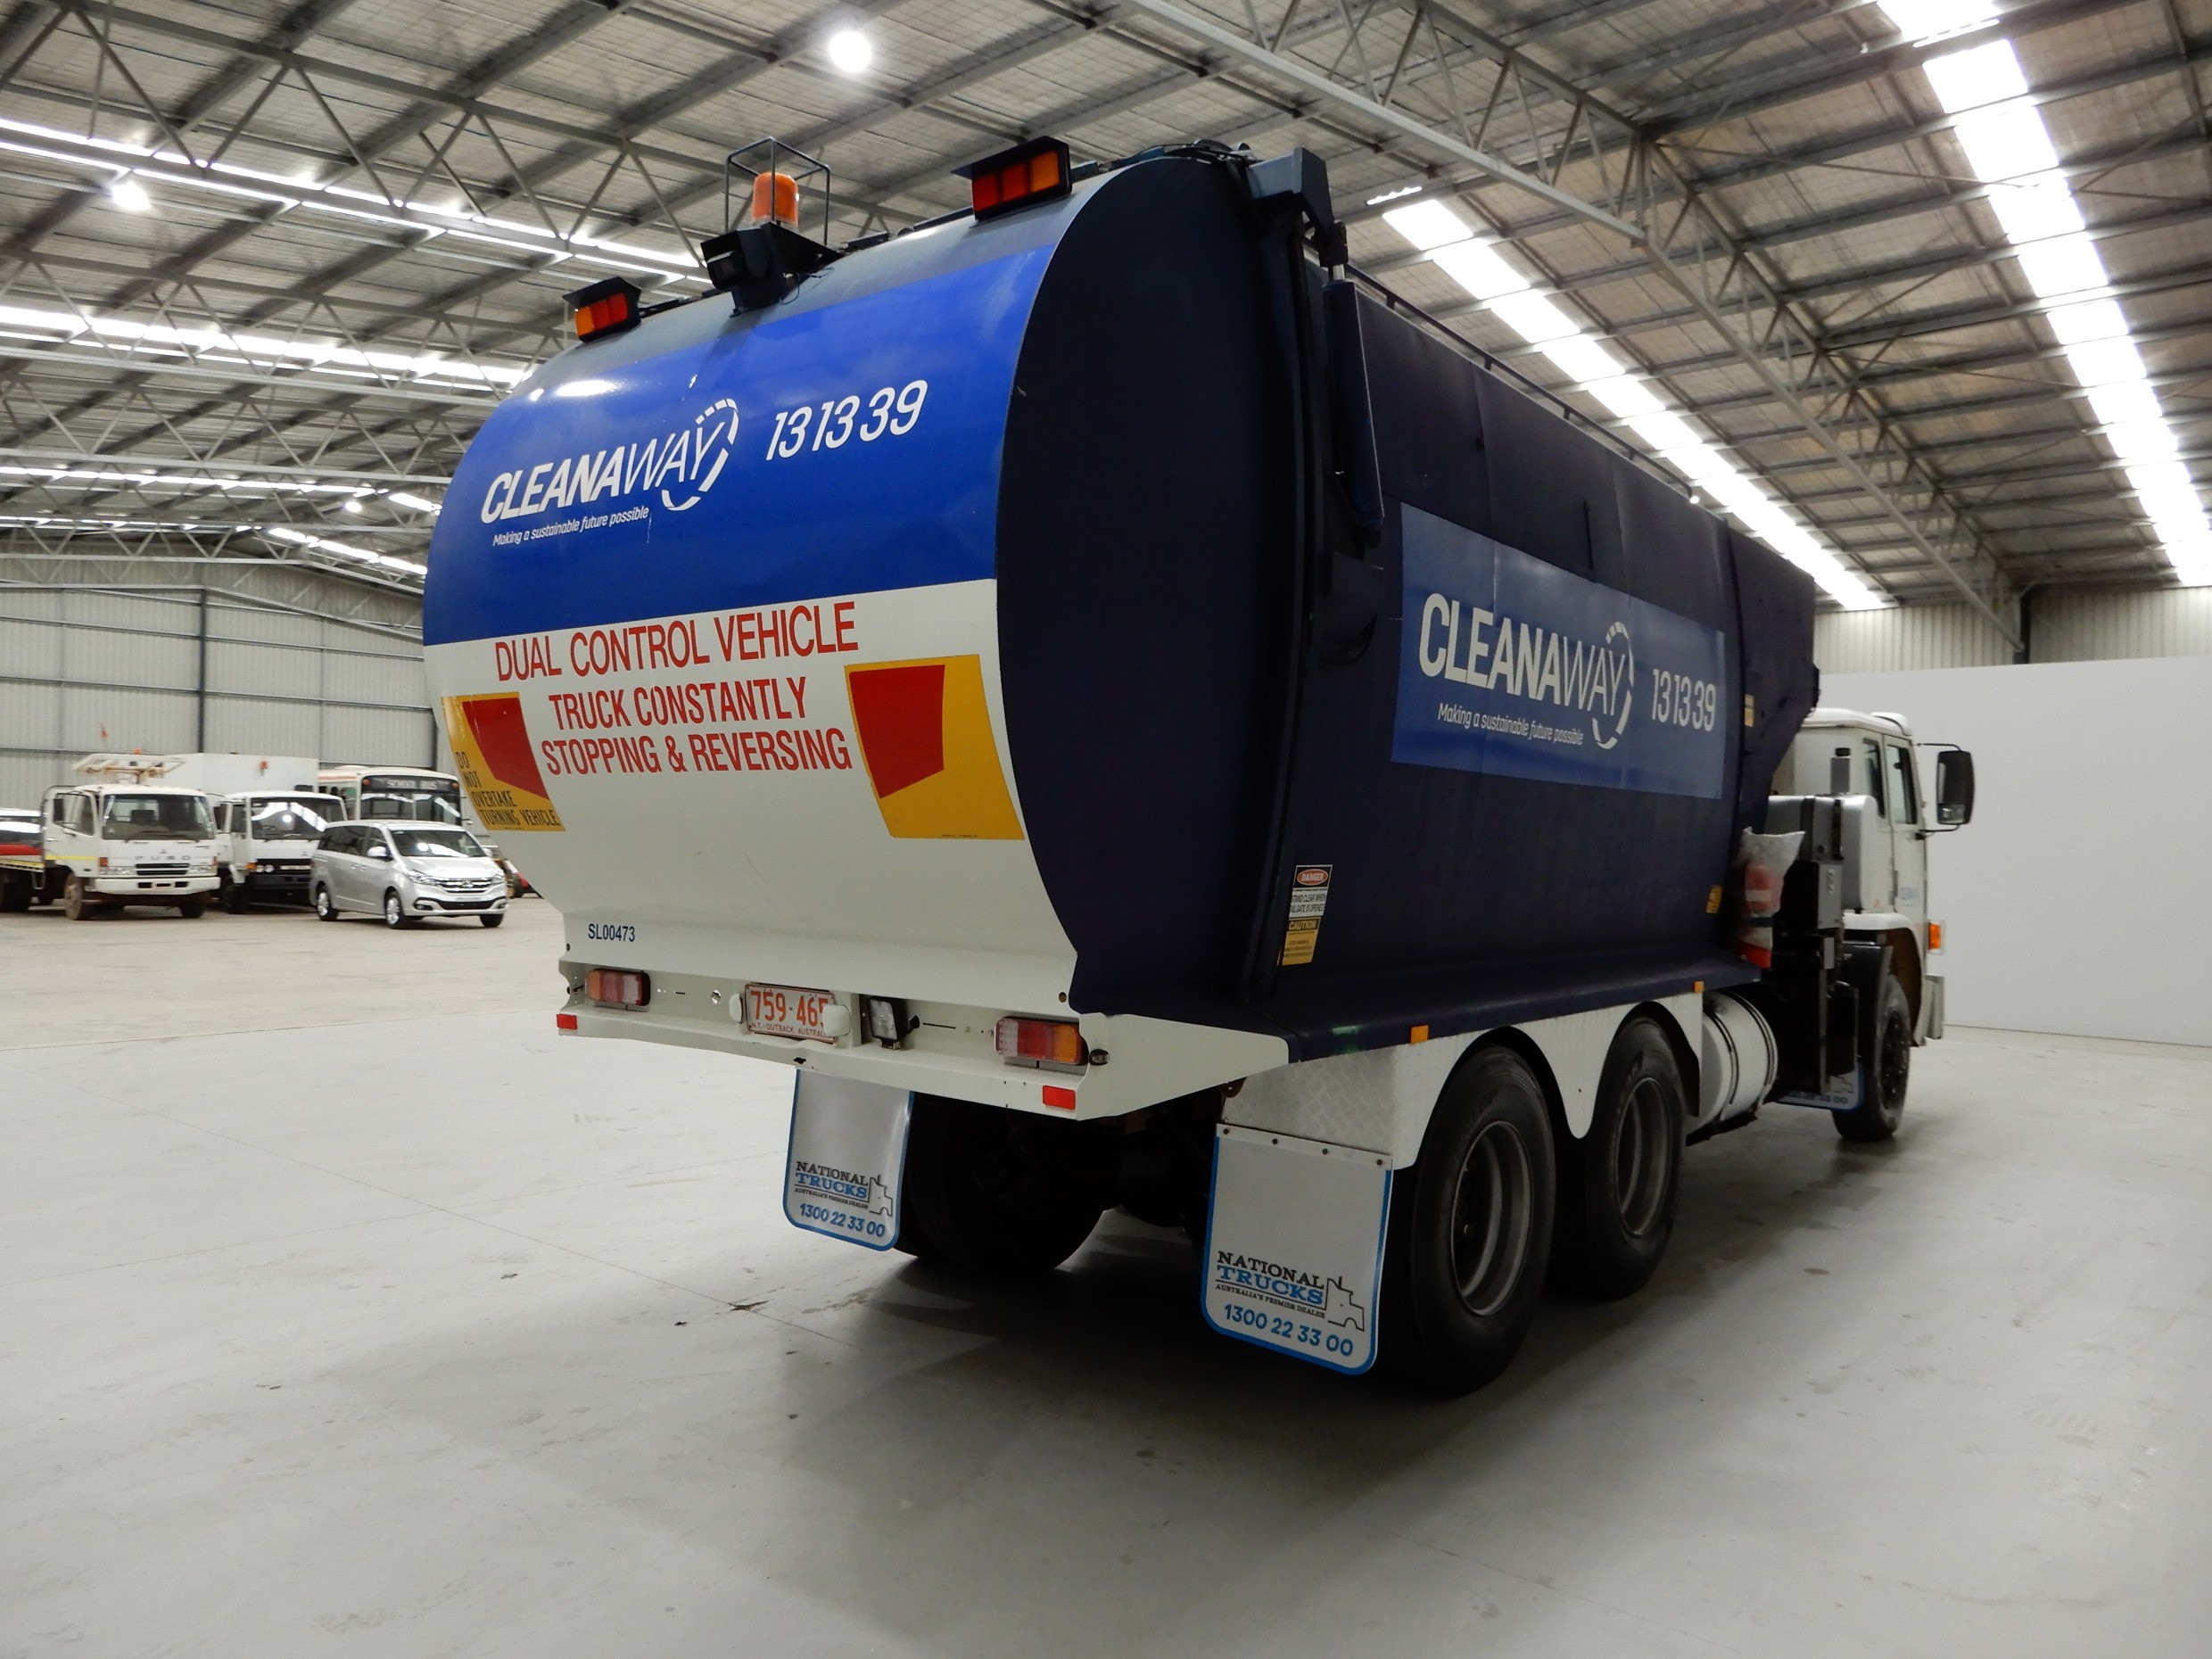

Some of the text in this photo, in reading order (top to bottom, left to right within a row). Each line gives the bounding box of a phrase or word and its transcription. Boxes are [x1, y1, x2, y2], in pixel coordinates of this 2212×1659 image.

[481, 421, 725, 524] CLEANAWAY
[492, 505, 649, 546] Making a sustainable future possible
[495, 600, 859, 682] DUAL CONTROL VEHICLE
[1418, 592, 1626, 718] CLEANAWAY
[549, 676, 806, 731] TRUCK CONSTANTLY
[1438, 703, 1584, 746] Making a sustainable future possible
[455, 751, 470, 769] DO
[541, 727, 852, 776] STOPPING & REVERSING
[462, 771, 483, 788] NOT
[471, 790, 517, 807] OVERTAKE
[479, 809, 561, 826] TURNING VEHICLE
[1301, 873, 1324, 881] DANGER
[588, 922, 636, 943] SL00473
[1289, 920, 1317, 930] CAUTION
[766, 1024, 794, 1033] OUTBACK
[795, 1172, 868, 1199] TRUCKS
[796, 1160, 869, 1186] NATIONAL
[800, 1203, 886, 1237] 1300 22 33 00
[1217, 1250, 1325, 1290] NATIONAL
[1217, 1265, 1324, 1305] TRUCKS
[1215, 1283, 1326, 1319] AUSTRALIA'S PREMIER DEALER
[1224, 1304, 1354, 1357] 1300 22 33 00
